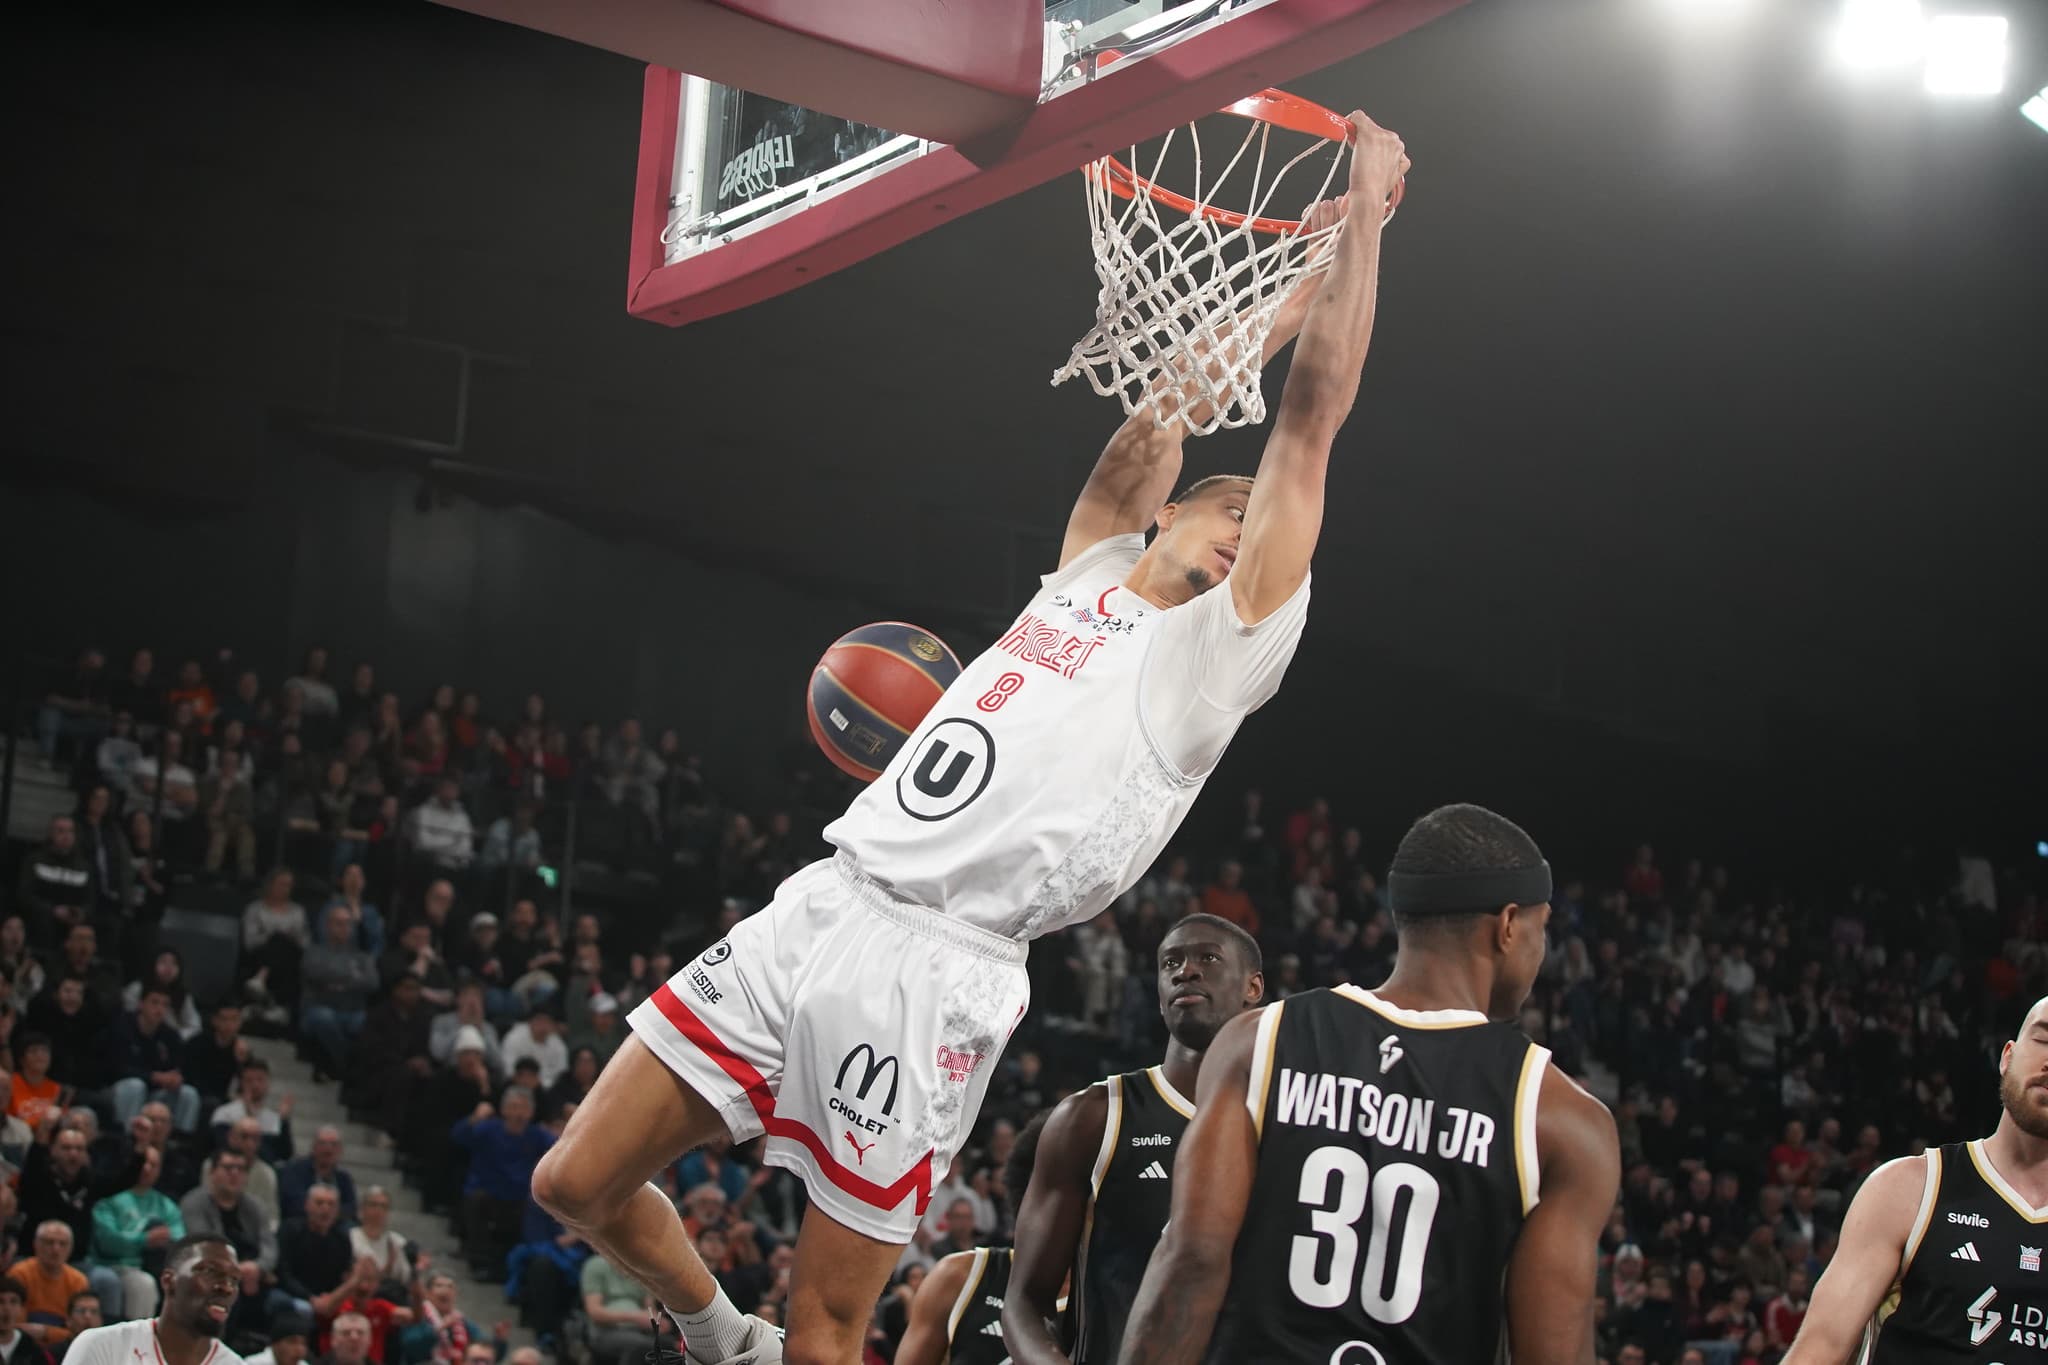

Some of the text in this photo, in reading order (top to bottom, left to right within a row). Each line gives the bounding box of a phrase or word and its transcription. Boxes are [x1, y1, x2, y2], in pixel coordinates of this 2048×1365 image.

[997, 612, 1107, 680] HOLET
[976, 672, 1025, 712] 8
[913, 739, 975, 798] U
[828, 1097, 888, 1136] CHOLET
[1276, 1067, 1496, 1168] WATSON JR
[1131, 1133, 1172, 1147] swile
[1288, 1145, 1440, 1325] 30
[1947, 1212, 1990, 1228] swile
[2010, 1303, 2048, 1331] LD
